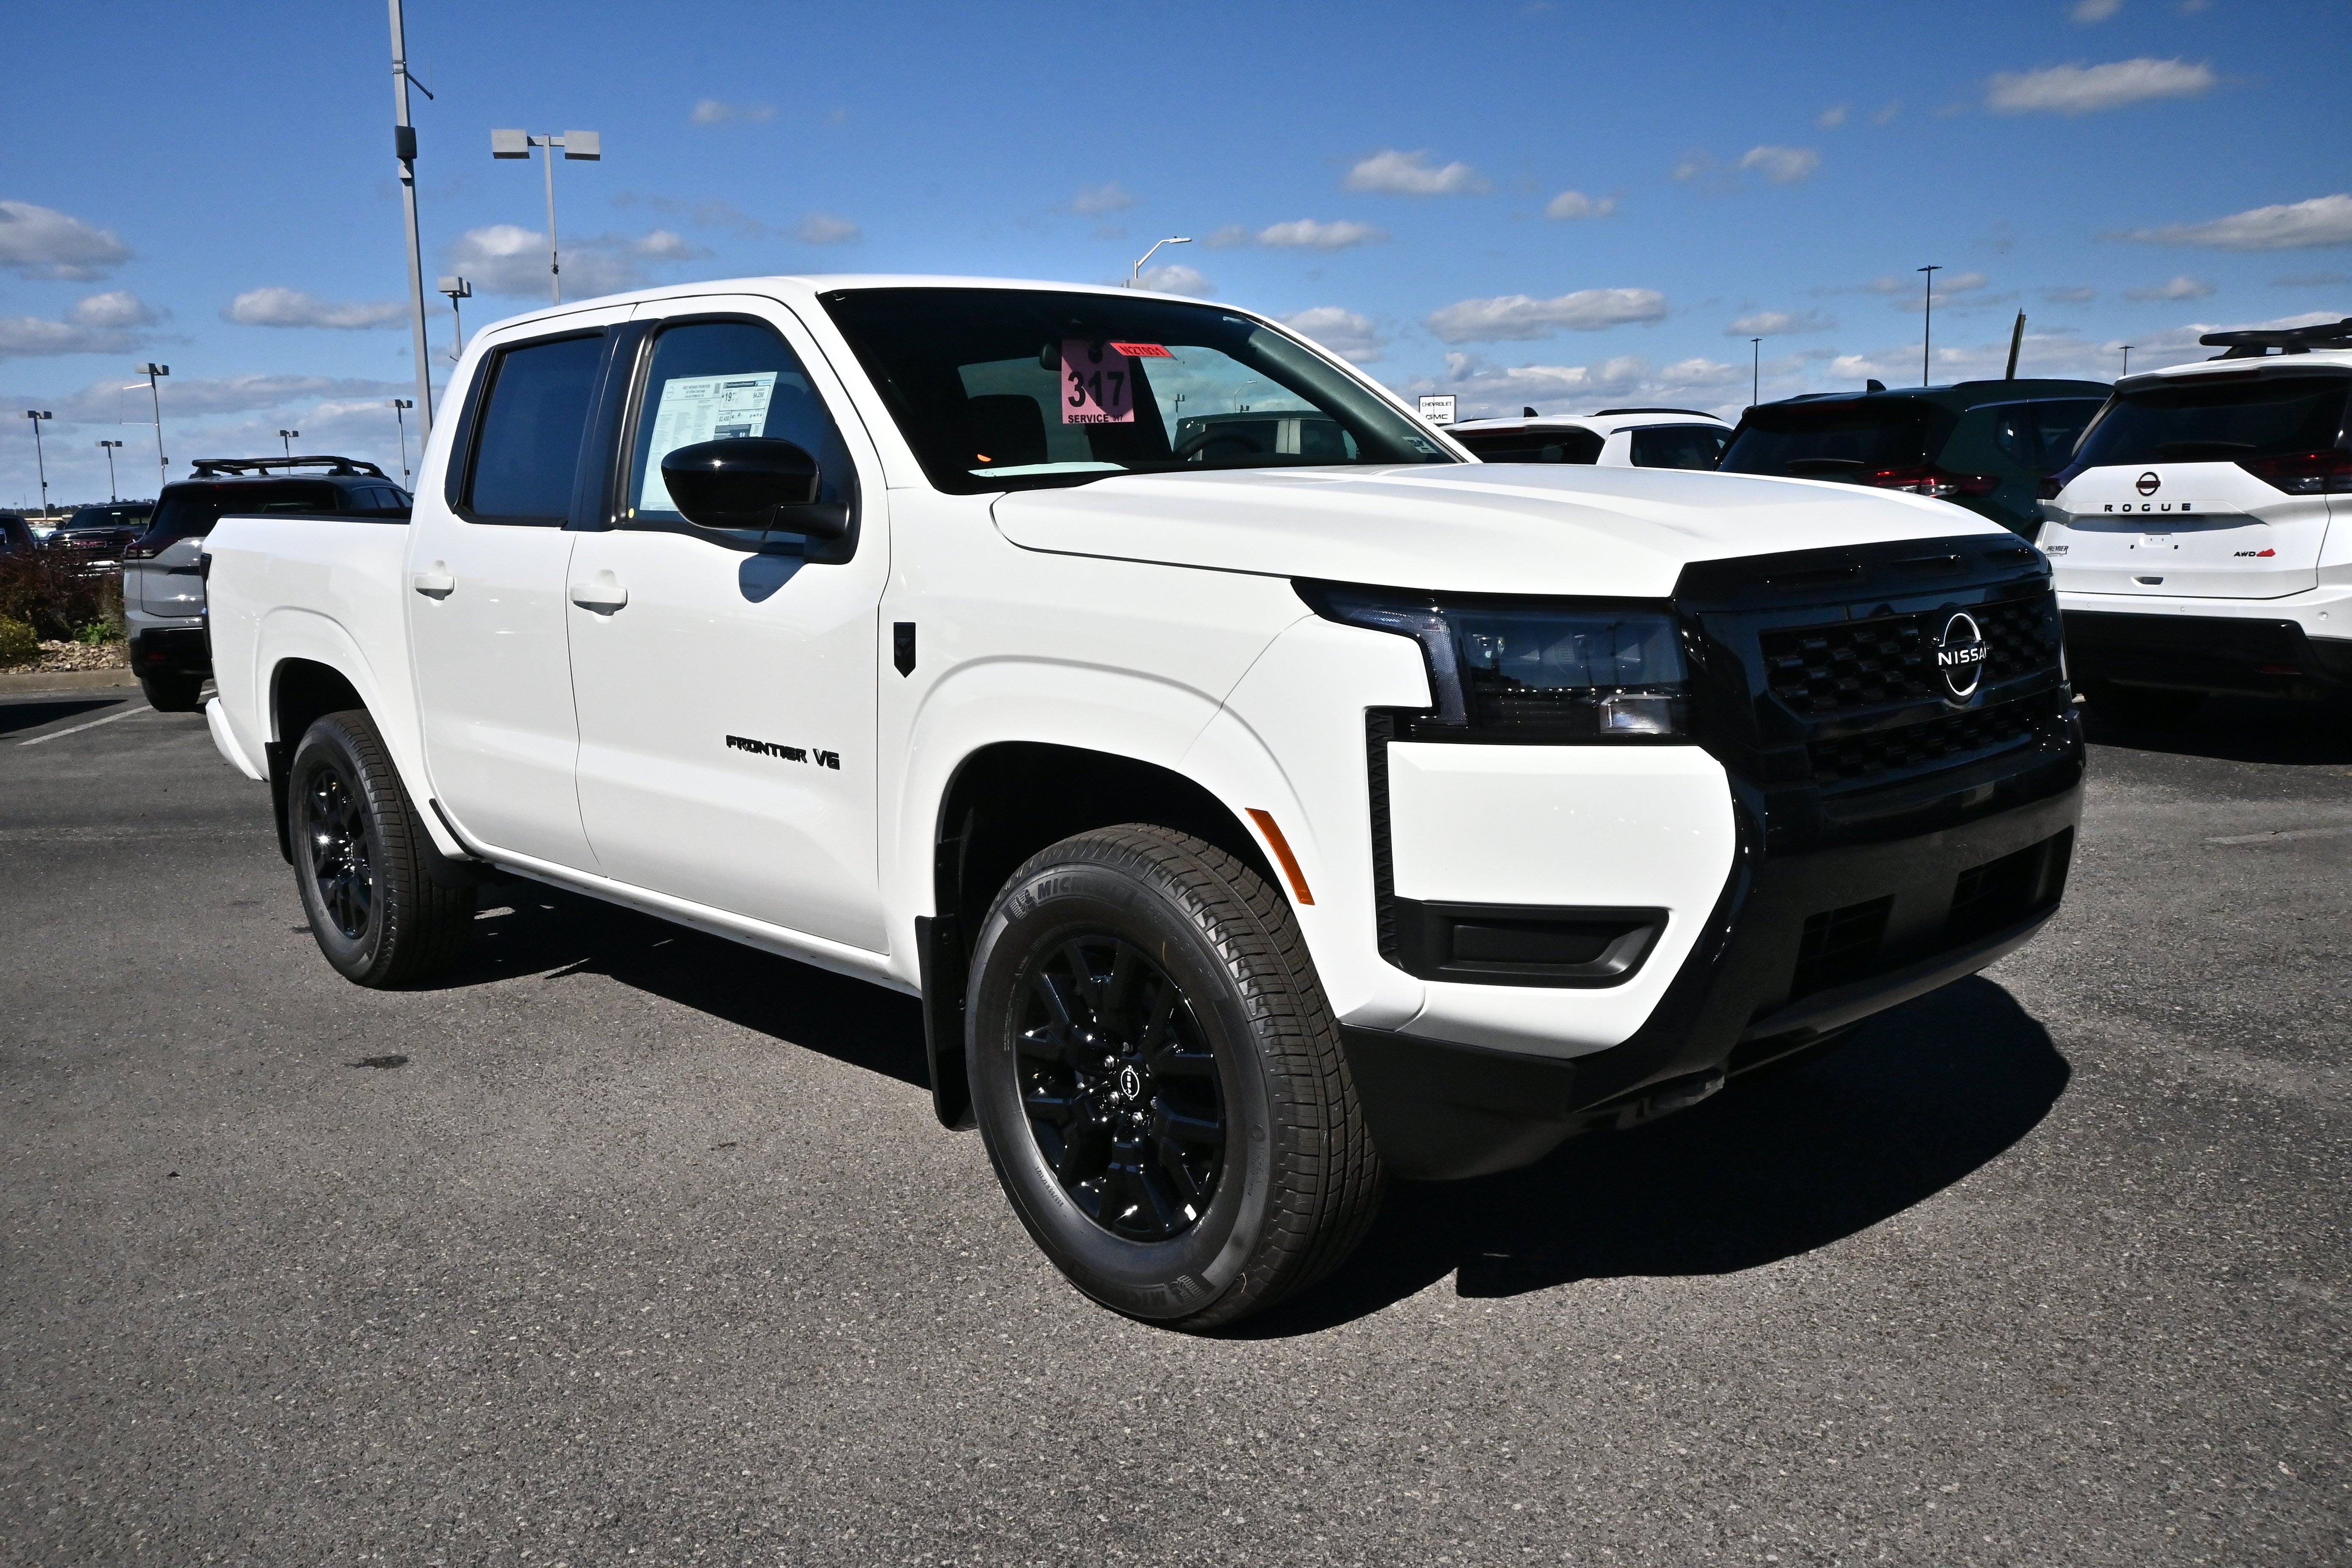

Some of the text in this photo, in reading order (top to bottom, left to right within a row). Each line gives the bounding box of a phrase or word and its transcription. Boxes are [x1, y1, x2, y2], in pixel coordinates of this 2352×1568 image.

[1119, 346, 1166, 356] N27031
[1068, 370, 1124, 408] 317
[725, 392, 732, 402] 19
[1068, 414, 1109, 423] SERVICE
[2104, 503, 2191, 512] ROGUE
[1938, 647, 1987, 666] NISSA
[726, 735, 840, 770] FRONTIER V6
